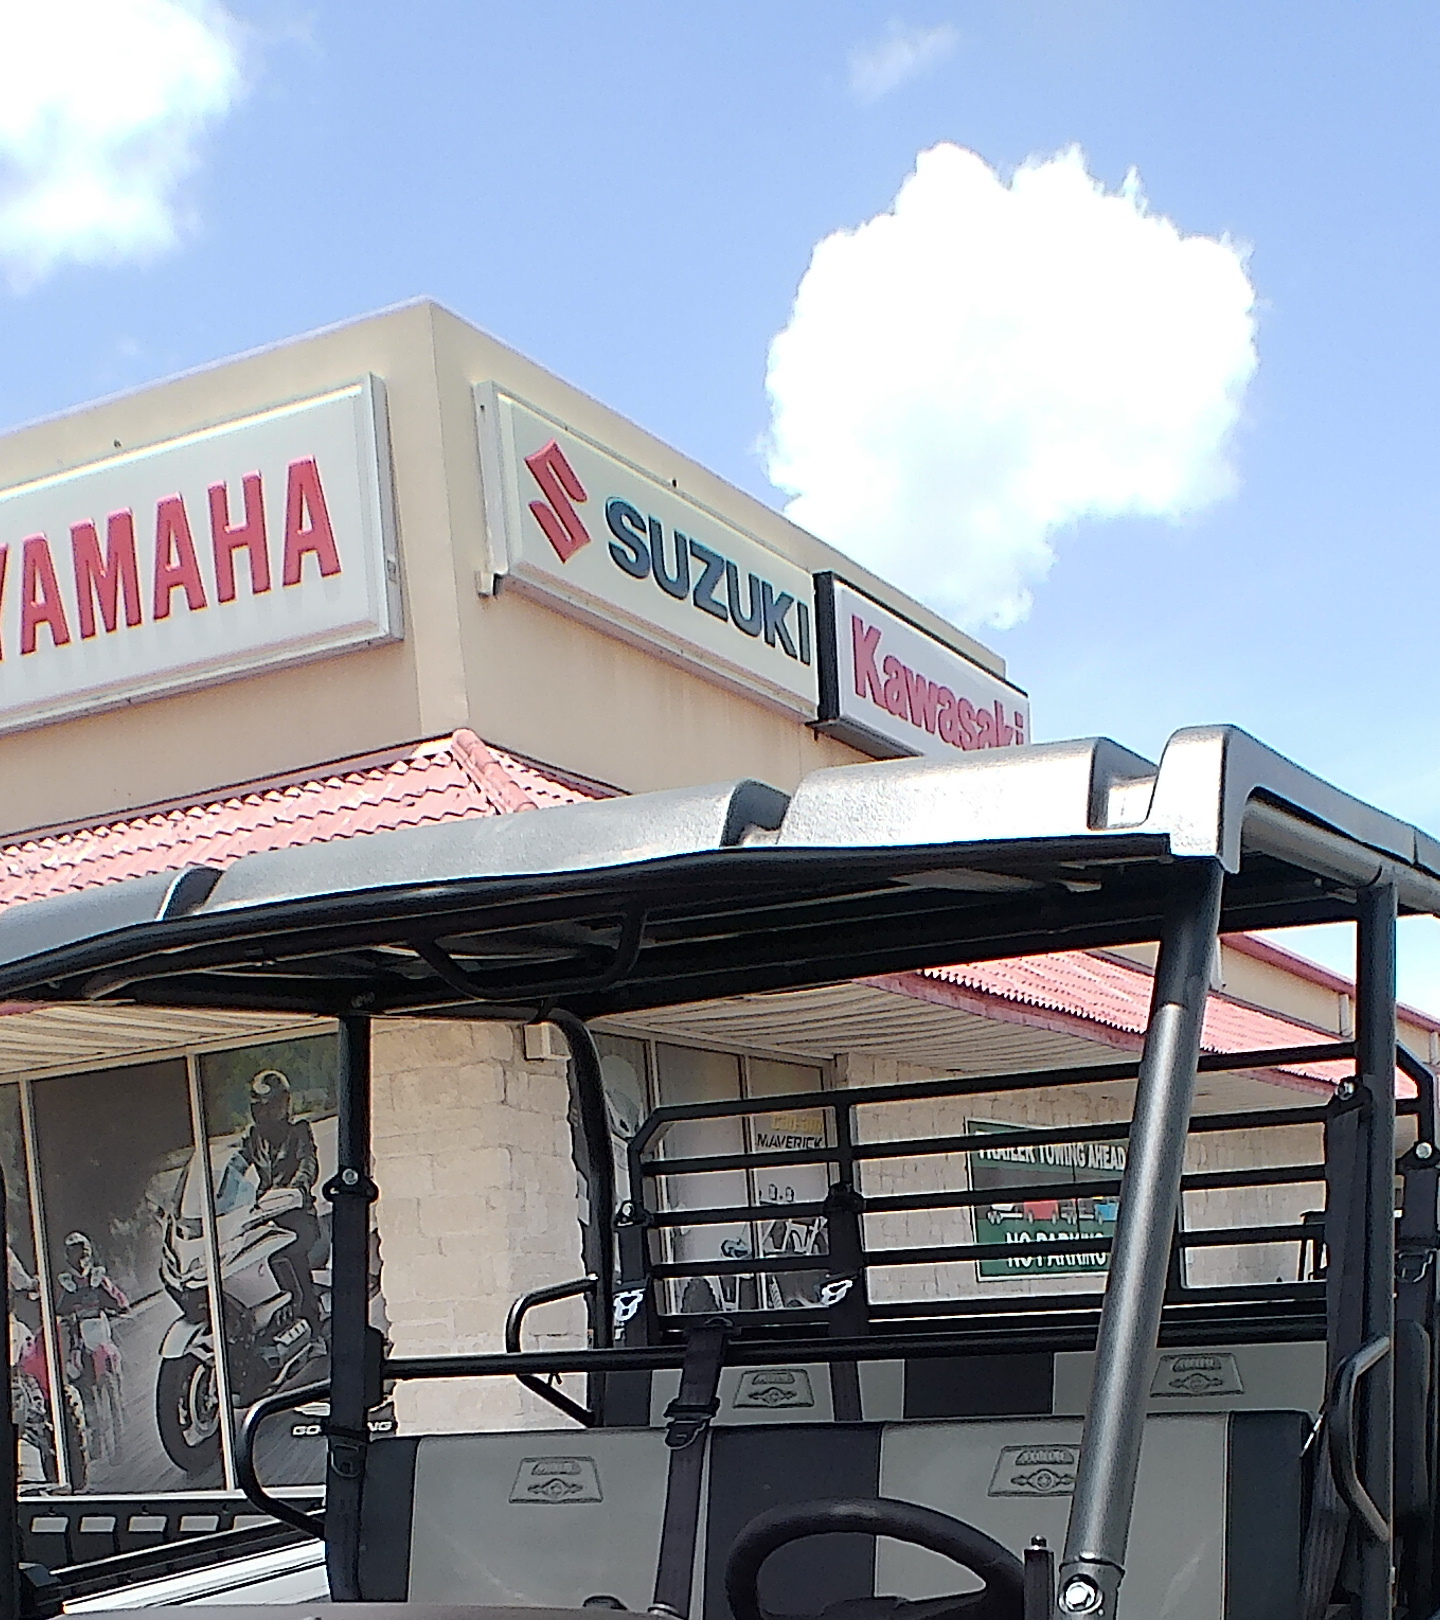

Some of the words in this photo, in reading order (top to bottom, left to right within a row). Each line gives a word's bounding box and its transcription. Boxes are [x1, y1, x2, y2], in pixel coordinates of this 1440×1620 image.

[605, 496, 811, 666] SUZUKI
[852, 614, 1024, 751] Kawasaki
[756, 1133, 823, 1149] MAVERICK
[1088, 1144, 1127, 1171] AHEAD
[1006, 1232, 1032, 1268] NO
